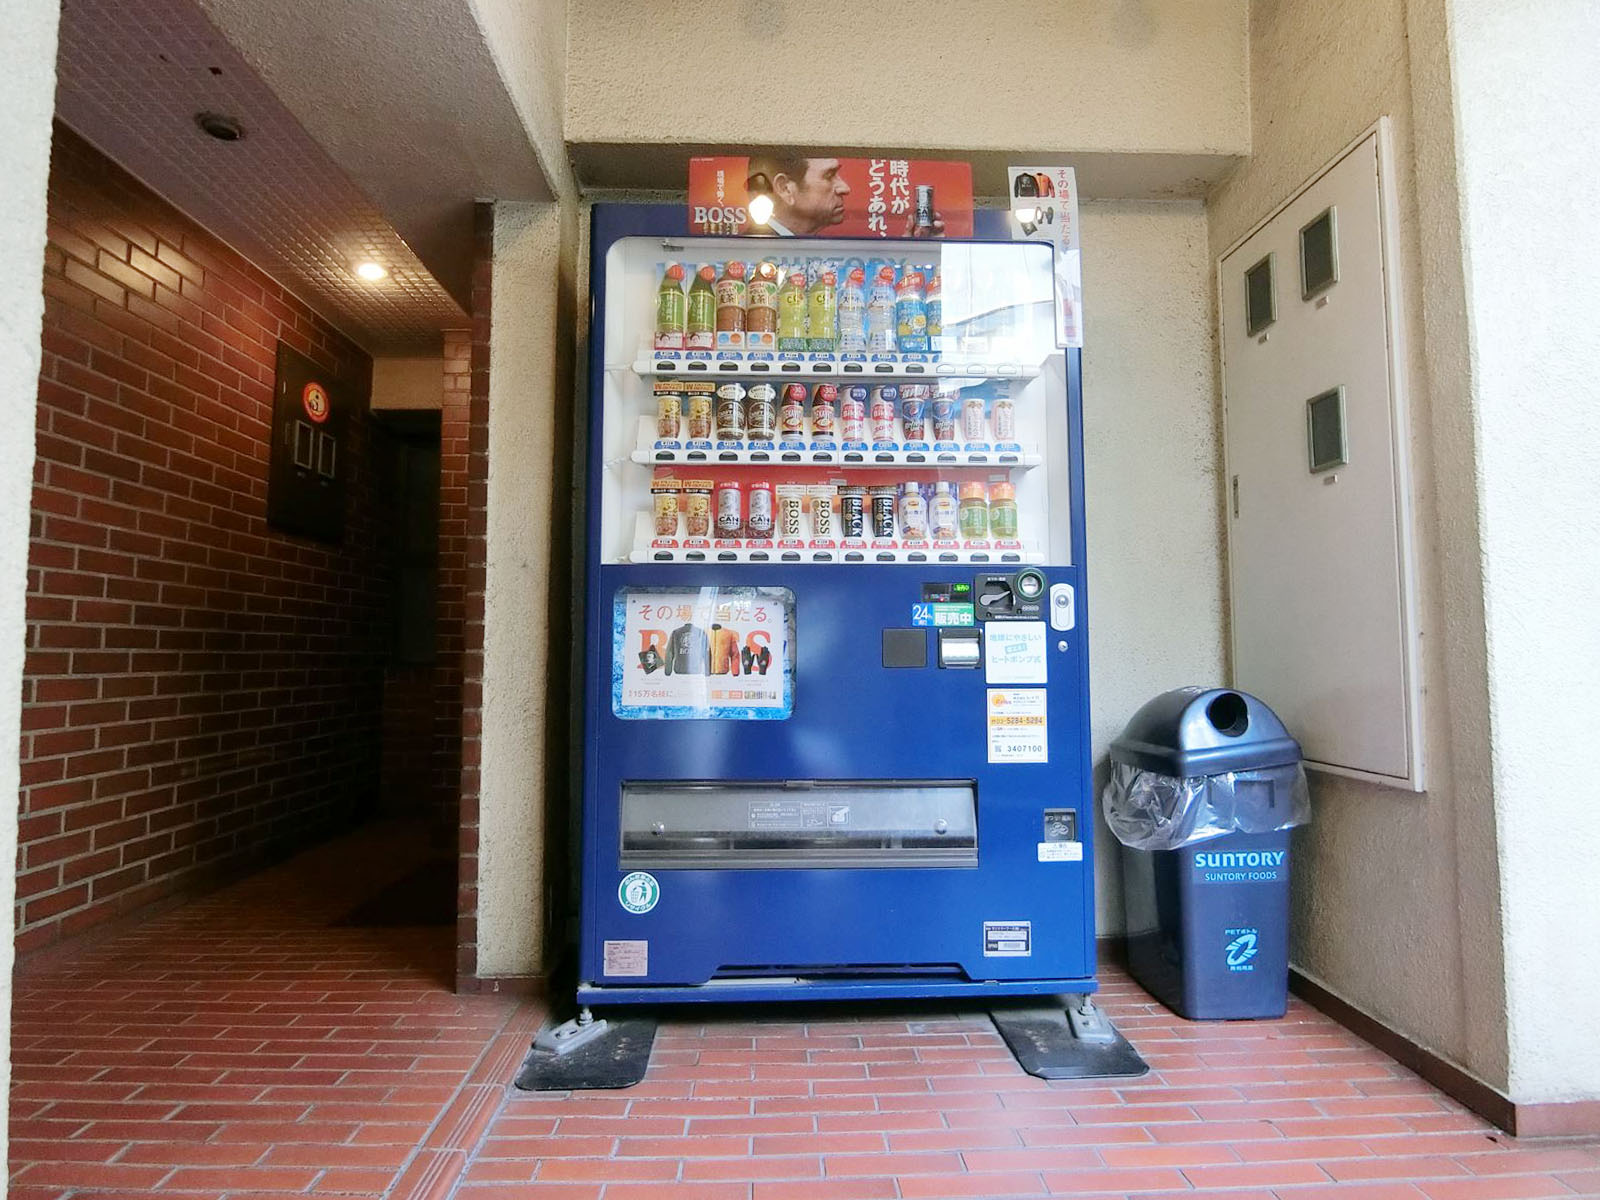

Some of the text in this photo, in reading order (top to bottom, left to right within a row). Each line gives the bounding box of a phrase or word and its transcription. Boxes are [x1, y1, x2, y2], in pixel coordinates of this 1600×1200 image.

[868, 159, 888, 237] どうあれ、
[889, 160, 910, 215] 時代が
[694, 206, 747, 224] BOSS
[789, 500, 800, 534] BOSS
[820, 500, 831, 534] BOSS
[852, 499, 862, 536] BLACK
[883, 499, 893, 536] BLACK
[912, 605, 928, 620] 24
[1007, 745, 1042, 753] 3407100
[1194, 851, 1284, 868] SUNTORY
[1205, 871, 1277, 881] SUNTORY FOODS
